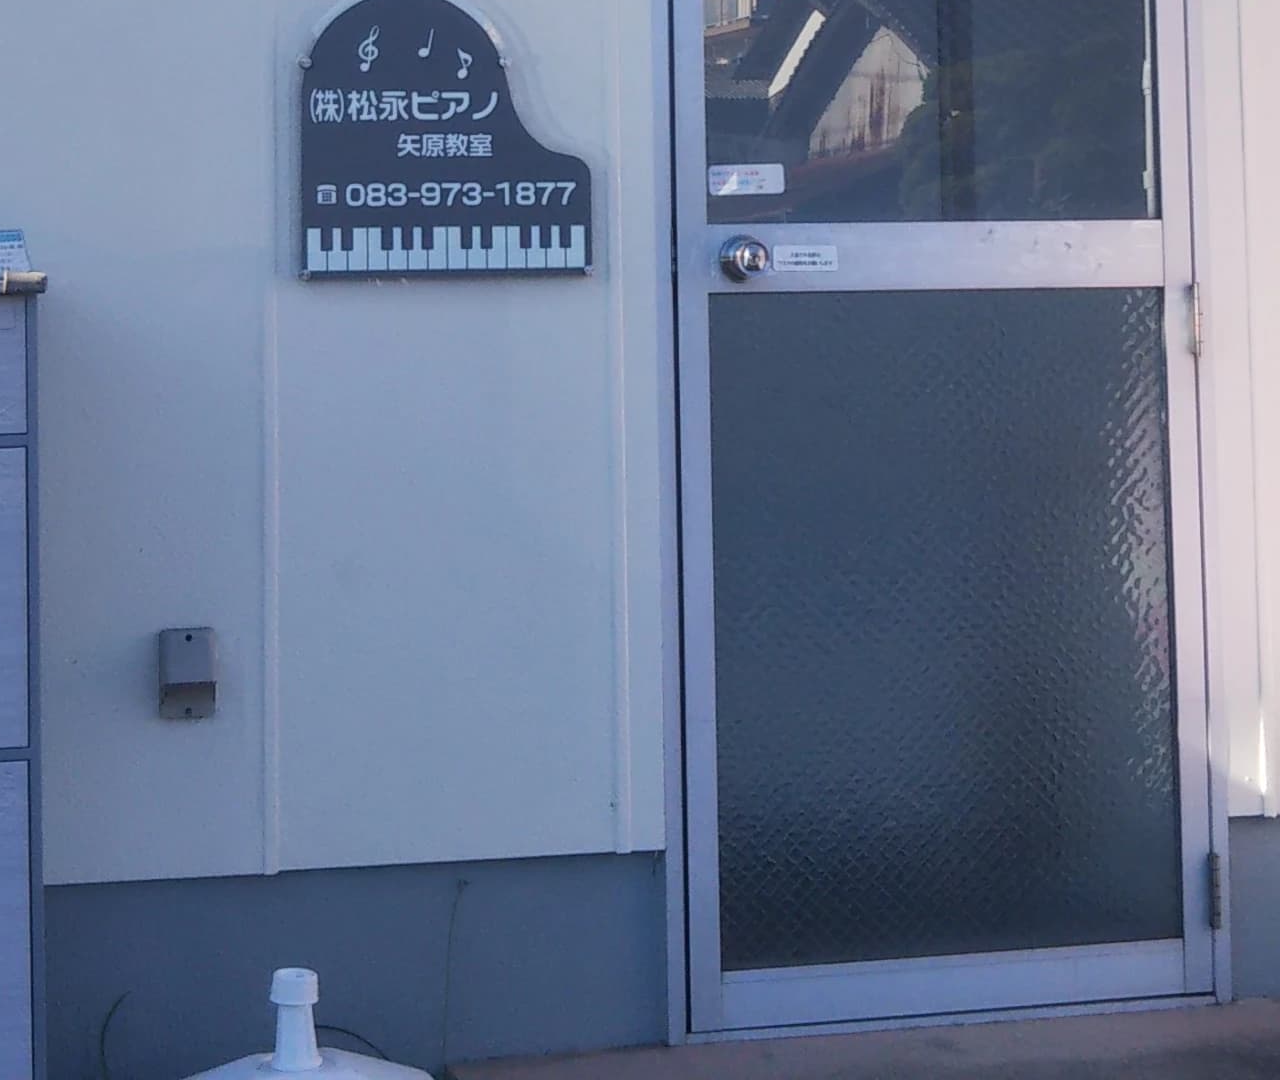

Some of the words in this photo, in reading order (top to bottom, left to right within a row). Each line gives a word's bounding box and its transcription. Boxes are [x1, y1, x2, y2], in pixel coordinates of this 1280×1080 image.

[397, 132, 494, 158] 矢原教室
[345, 181, 577, 208] 083-973-1877
